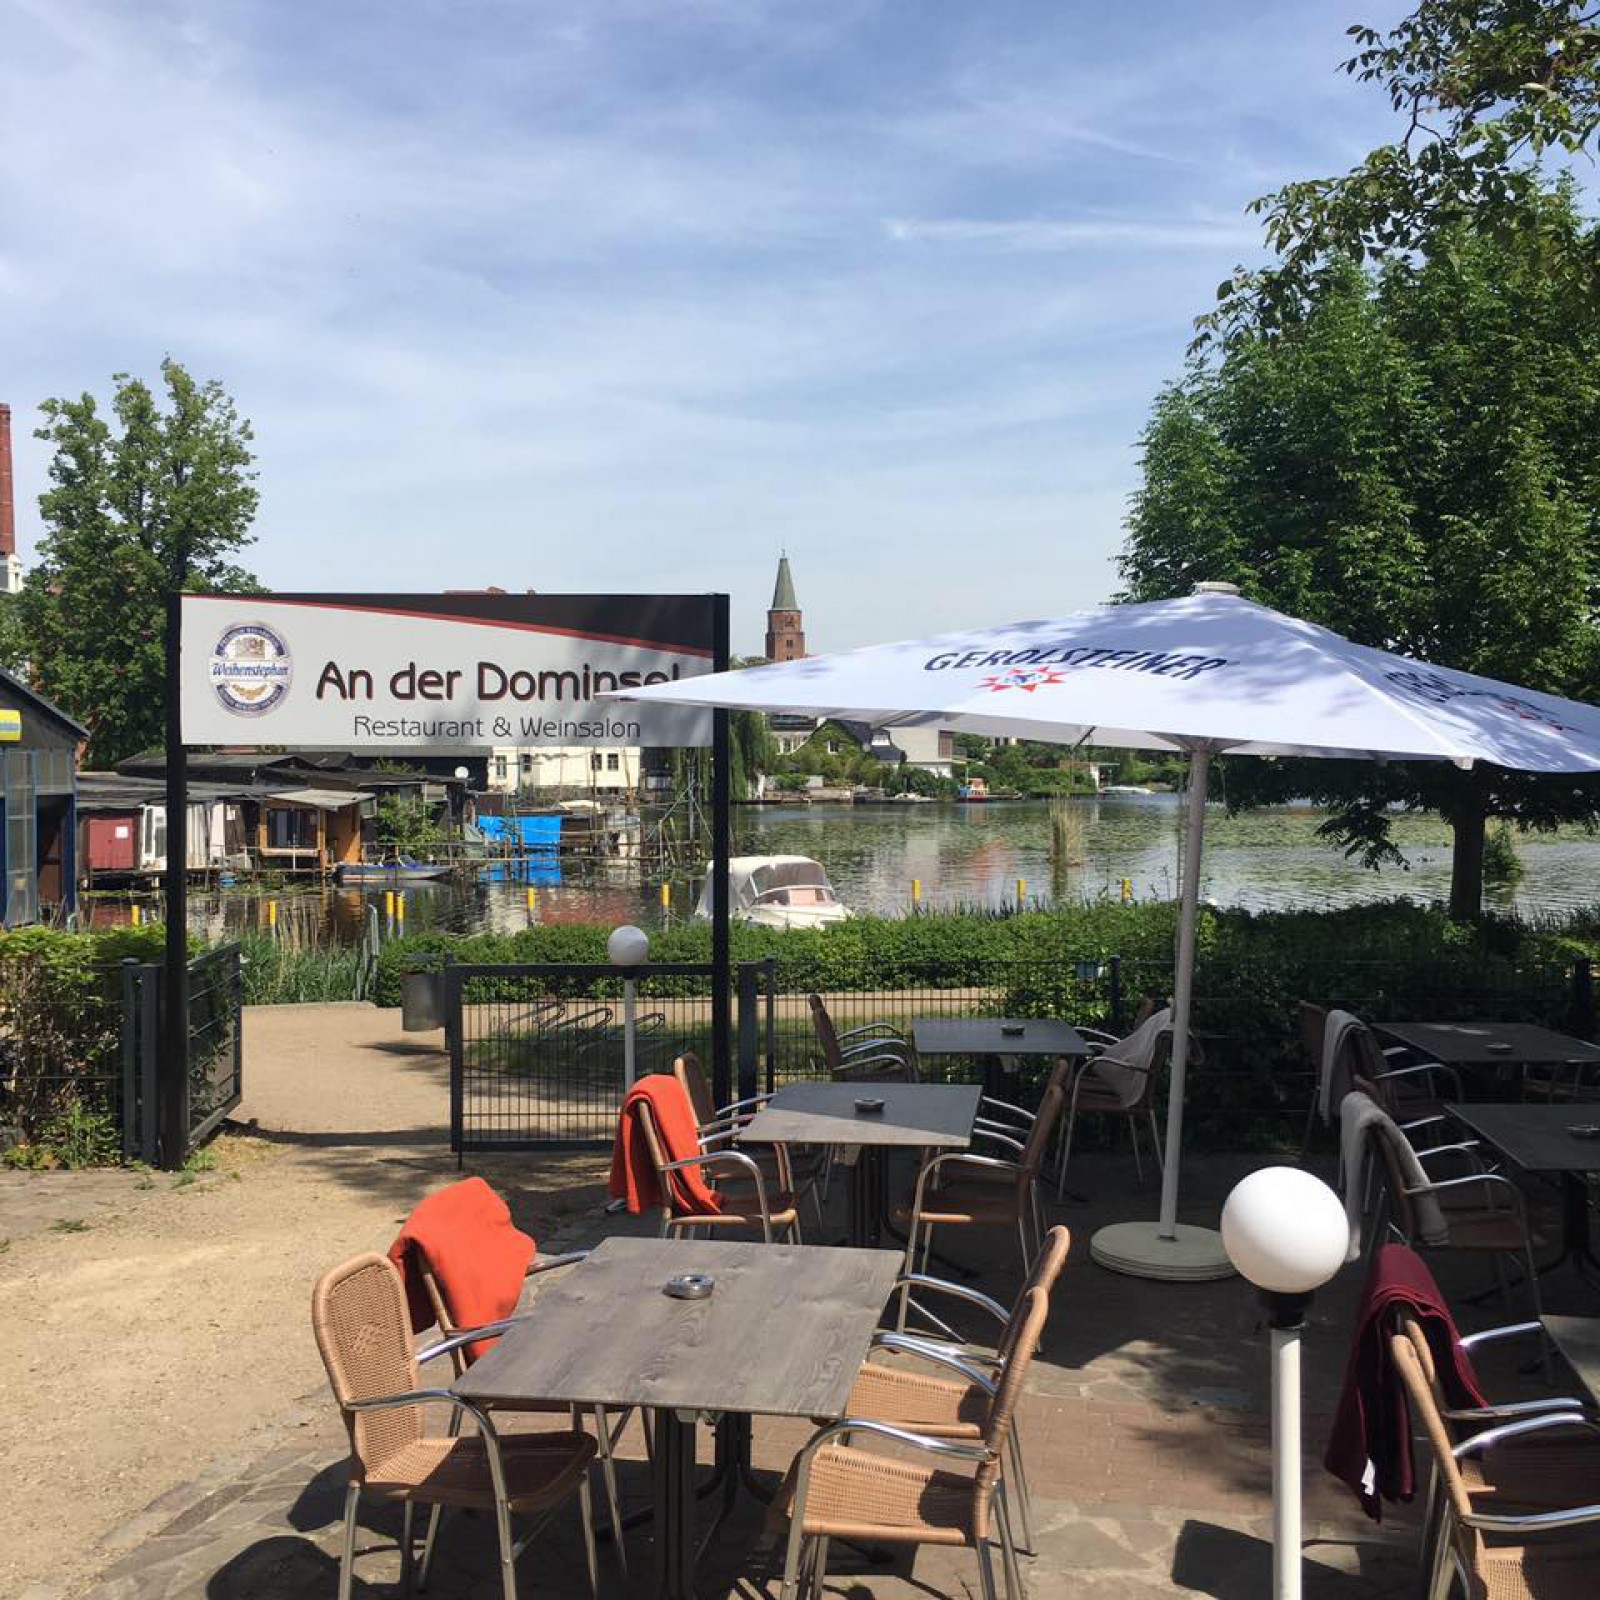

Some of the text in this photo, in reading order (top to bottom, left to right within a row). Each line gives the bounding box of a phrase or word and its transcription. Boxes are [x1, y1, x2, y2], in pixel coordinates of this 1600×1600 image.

[316, 661, 373, 699] An
[389, 661, 463, 700] der
[923, 647, 1228, 681] GEROLSTEINER
[354, 716, 641, 738] Restaurant & Weinsalon
